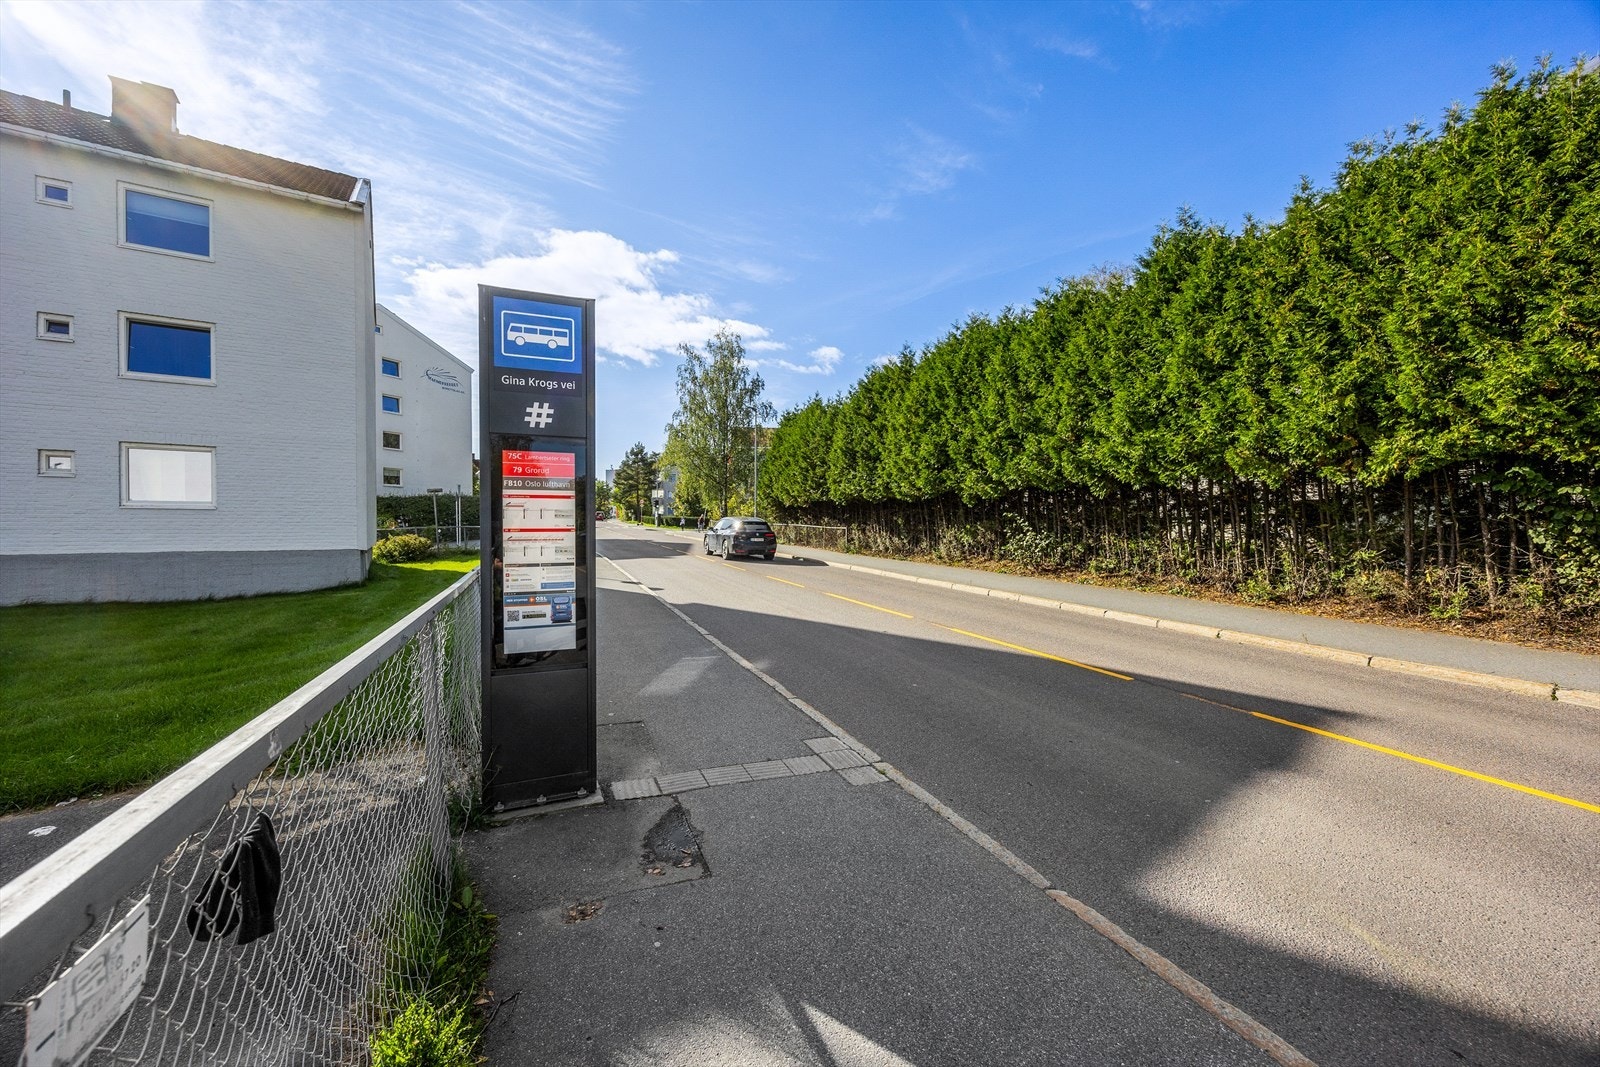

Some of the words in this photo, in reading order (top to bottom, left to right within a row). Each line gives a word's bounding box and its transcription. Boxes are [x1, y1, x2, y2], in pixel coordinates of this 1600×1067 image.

[502, 375, 525, 386] Gina
[528, 377, 558, 390] Krogs
[561, 381, 576, 390] vei
[543, 480, 571, 488] lufthavn
